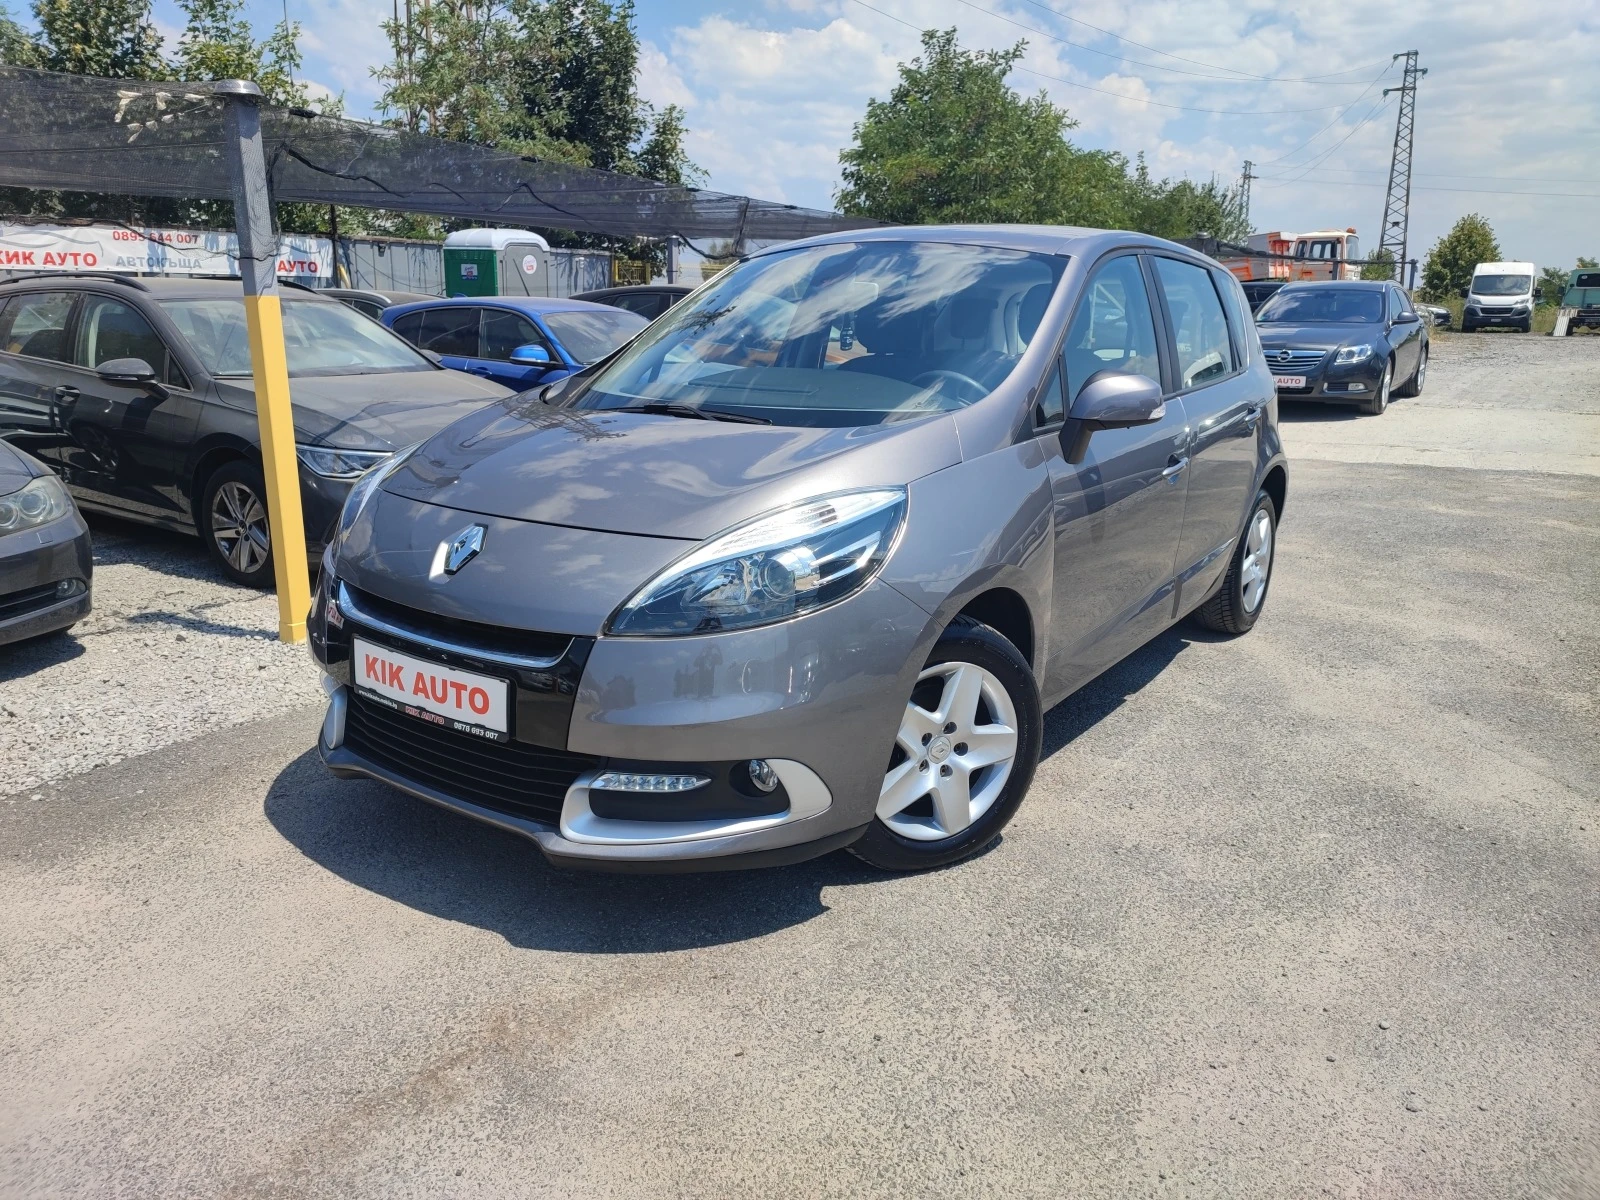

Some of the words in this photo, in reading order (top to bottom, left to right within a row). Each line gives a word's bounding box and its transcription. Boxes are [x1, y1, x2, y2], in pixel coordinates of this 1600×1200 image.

[149, 232, 173, 244] 644
[176, 233, 199, 244] 007
[42, 251, 97, 267] АУТО
[115, 255, 203, 270] АВТОКЪЩА
[277, 260, 318, 273] АУТО
[365, 653, 405, 692] KIK
[412, 671, 490, 715] AUTO
[405, 705, 421, 718] KIK
[420, 711, 445, 725] AUTO
[485, 731, 499, 740] 007
